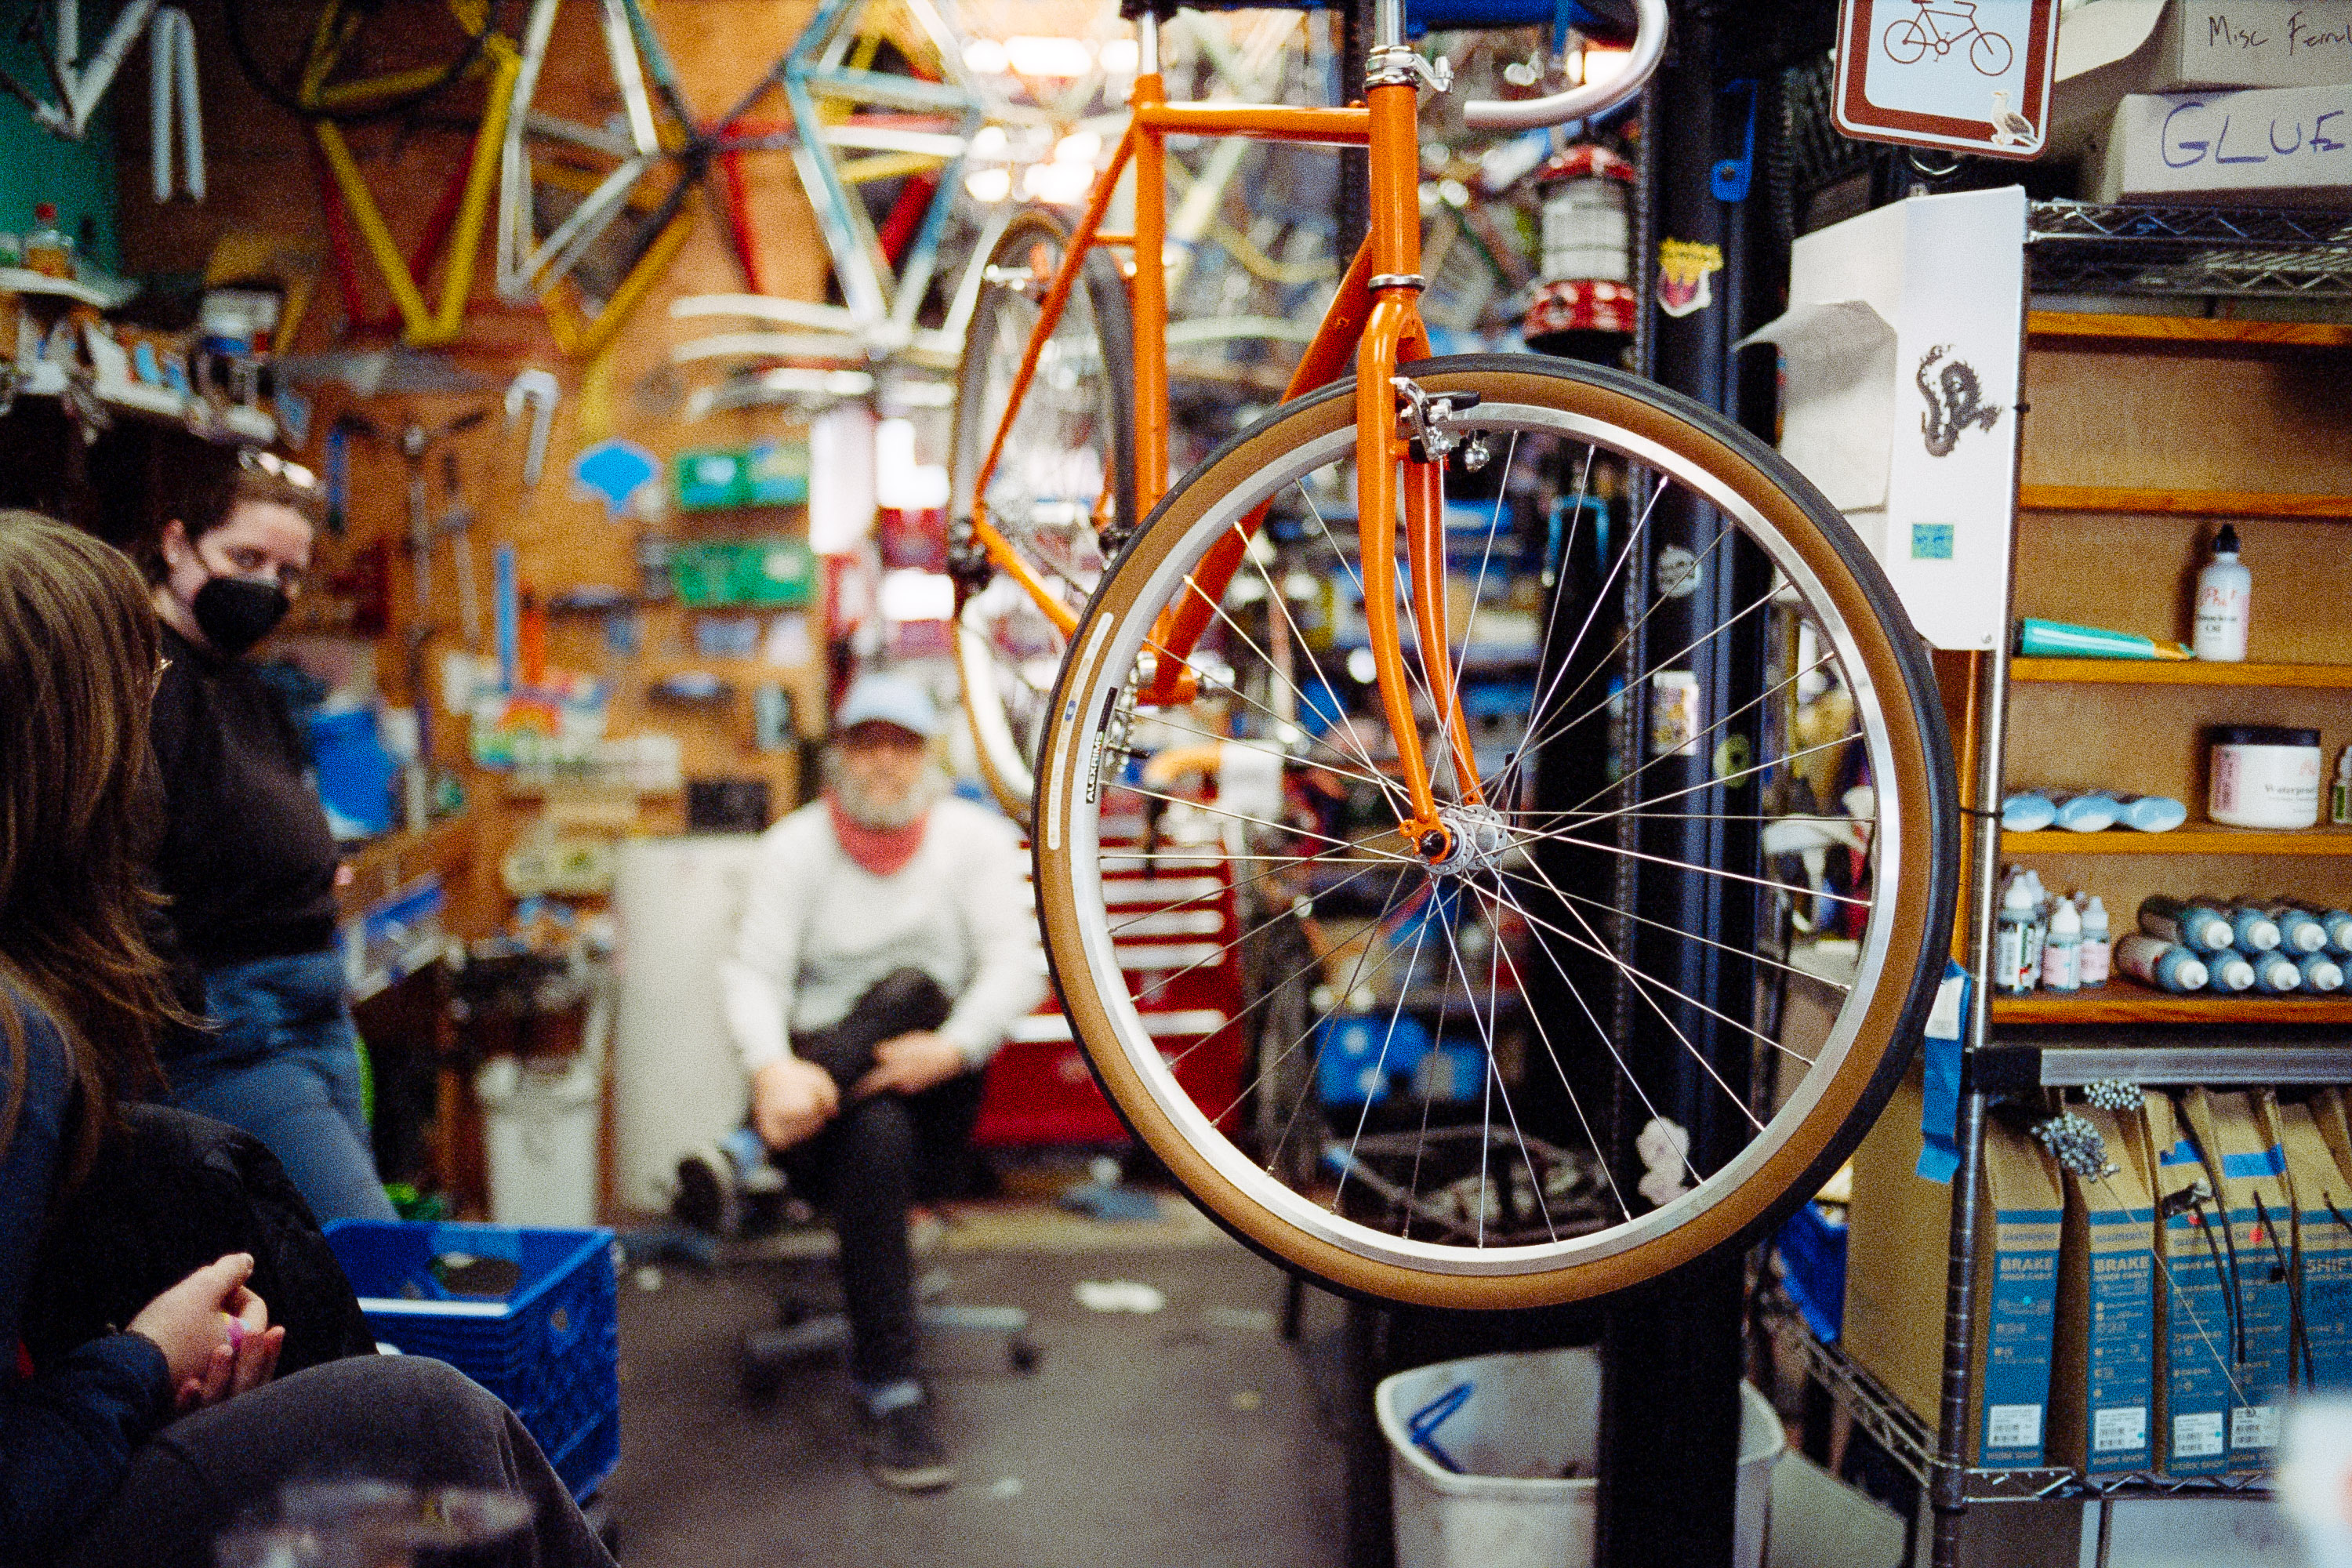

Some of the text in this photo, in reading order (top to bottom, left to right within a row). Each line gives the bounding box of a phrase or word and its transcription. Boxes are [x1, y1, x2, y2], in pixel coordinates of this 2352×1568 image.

[2208, 15, 2269, 49] Misc
[2161, 101, 2346, 169] GLUE
[2001, 1257, 2053, 1271] BRAKE
[2094, 1256, 2150, 1272] BRAKE
